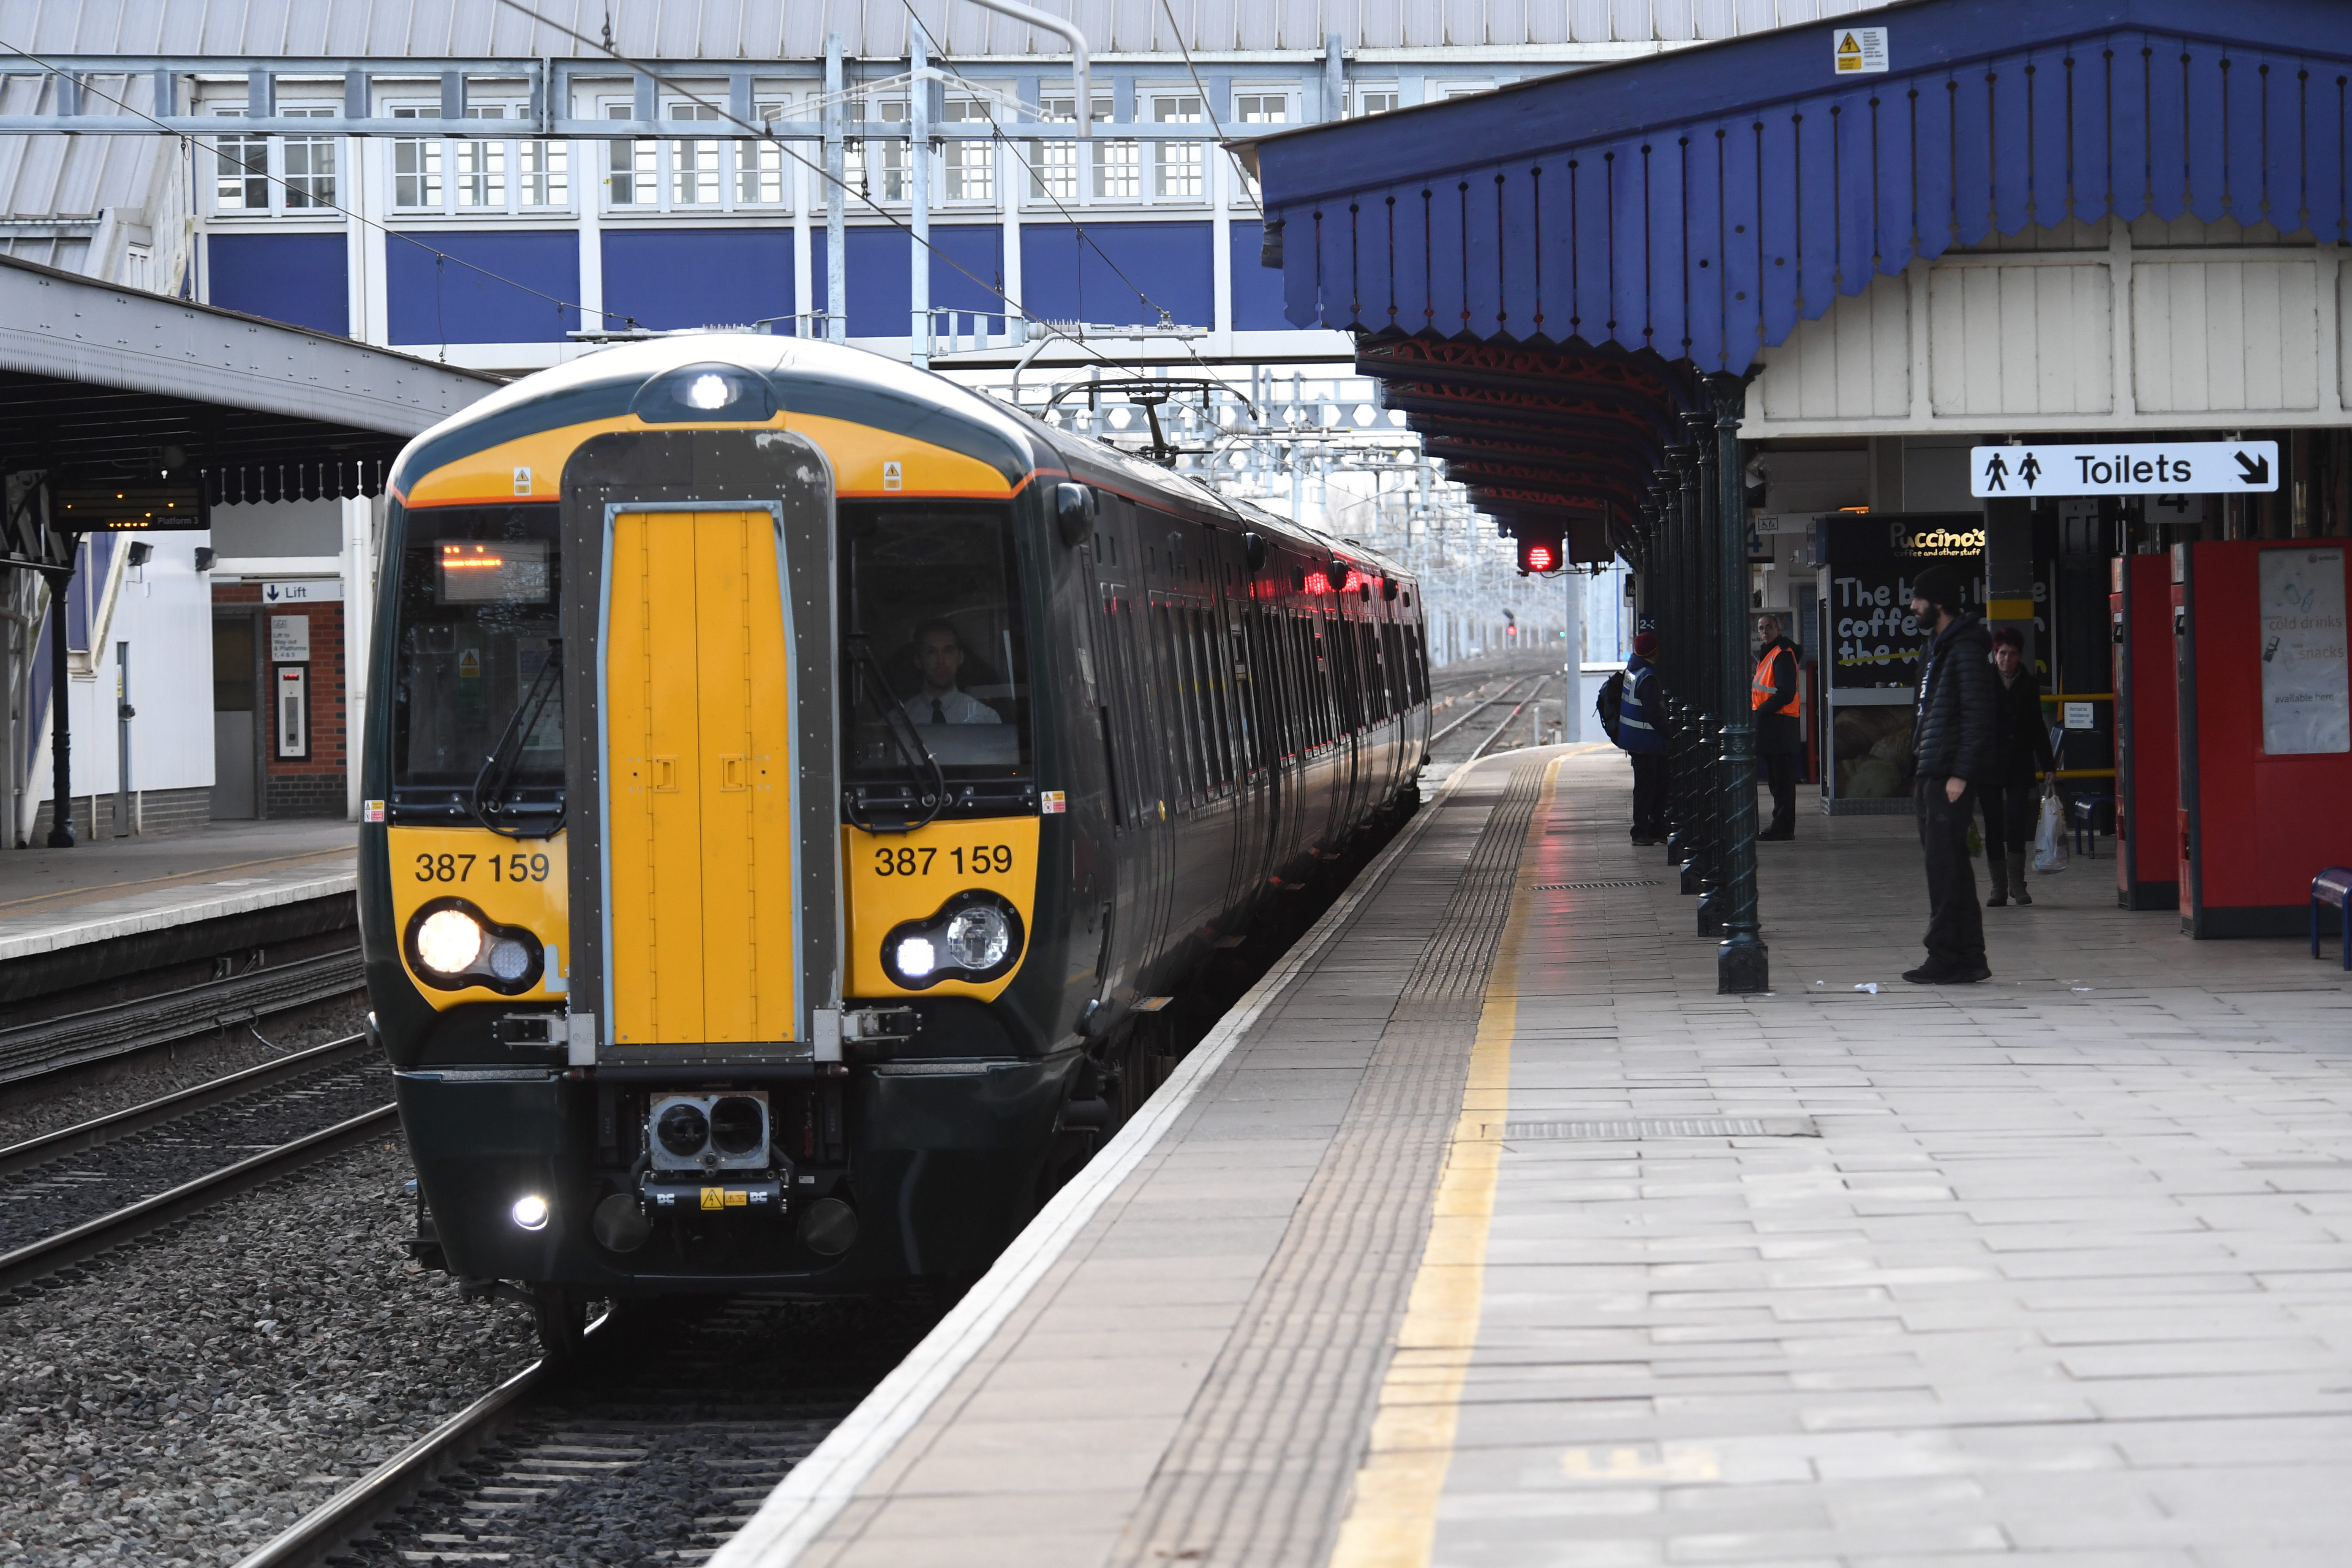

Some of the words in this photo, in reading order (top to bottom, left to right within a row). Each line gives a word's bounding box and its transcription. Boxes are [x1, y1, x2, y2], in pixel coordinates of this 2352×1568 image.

[2074, 454, 2191, 484] Toilets
[2157, 493, 2189, 513] 4
[1890, 522, 1985, 548] Puccino's
[1894, 549, 1922, 557] coffee
[1938, 548, 1960, 556] other
[1960, 548, 1981, 556] stuff
[286, 587, 306, 598] Lift
[1834, 577, 1891, 607] The
[1838, 607, 1933, 638] coffe
[2269, 616, 2296, 631] cold
[2301, 615, 2342, 629] drinks
[1838, 639, 1891, 667] the
[2299, 645, 2344, 659] snacks
[2275, 693, 2313, 704] available
[2315, 693, 2334, 701] here
[415, 853, 477, 882] 387
[488, 853, 550, 882] 159
[874, 847, 937, 877] 387
[950, 844, 1013, 874] 159
